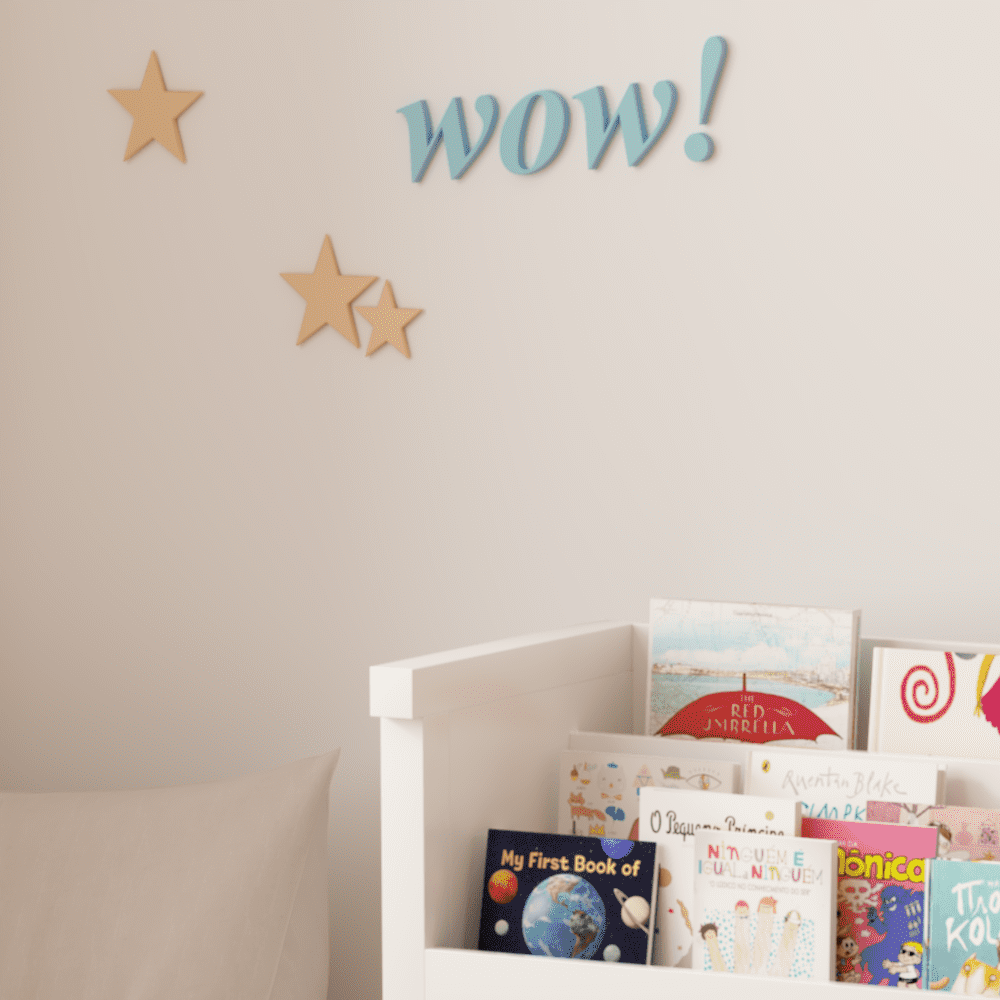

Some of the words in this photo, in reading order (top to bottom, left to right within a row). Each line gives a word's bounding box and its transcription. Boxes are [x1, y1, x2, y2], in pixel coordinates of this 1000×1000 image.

[396, 35, 729, 183] wow!
[731, 703, 765, 718] RED
[846, 771, 907, 798] Blake
[651, 810, 662, 833] O
[501, 849, 524, 871] My
[528, 851, 569, 871] First
[574, 854, 617, 876] Book
[621, 859, 641, 877] of
